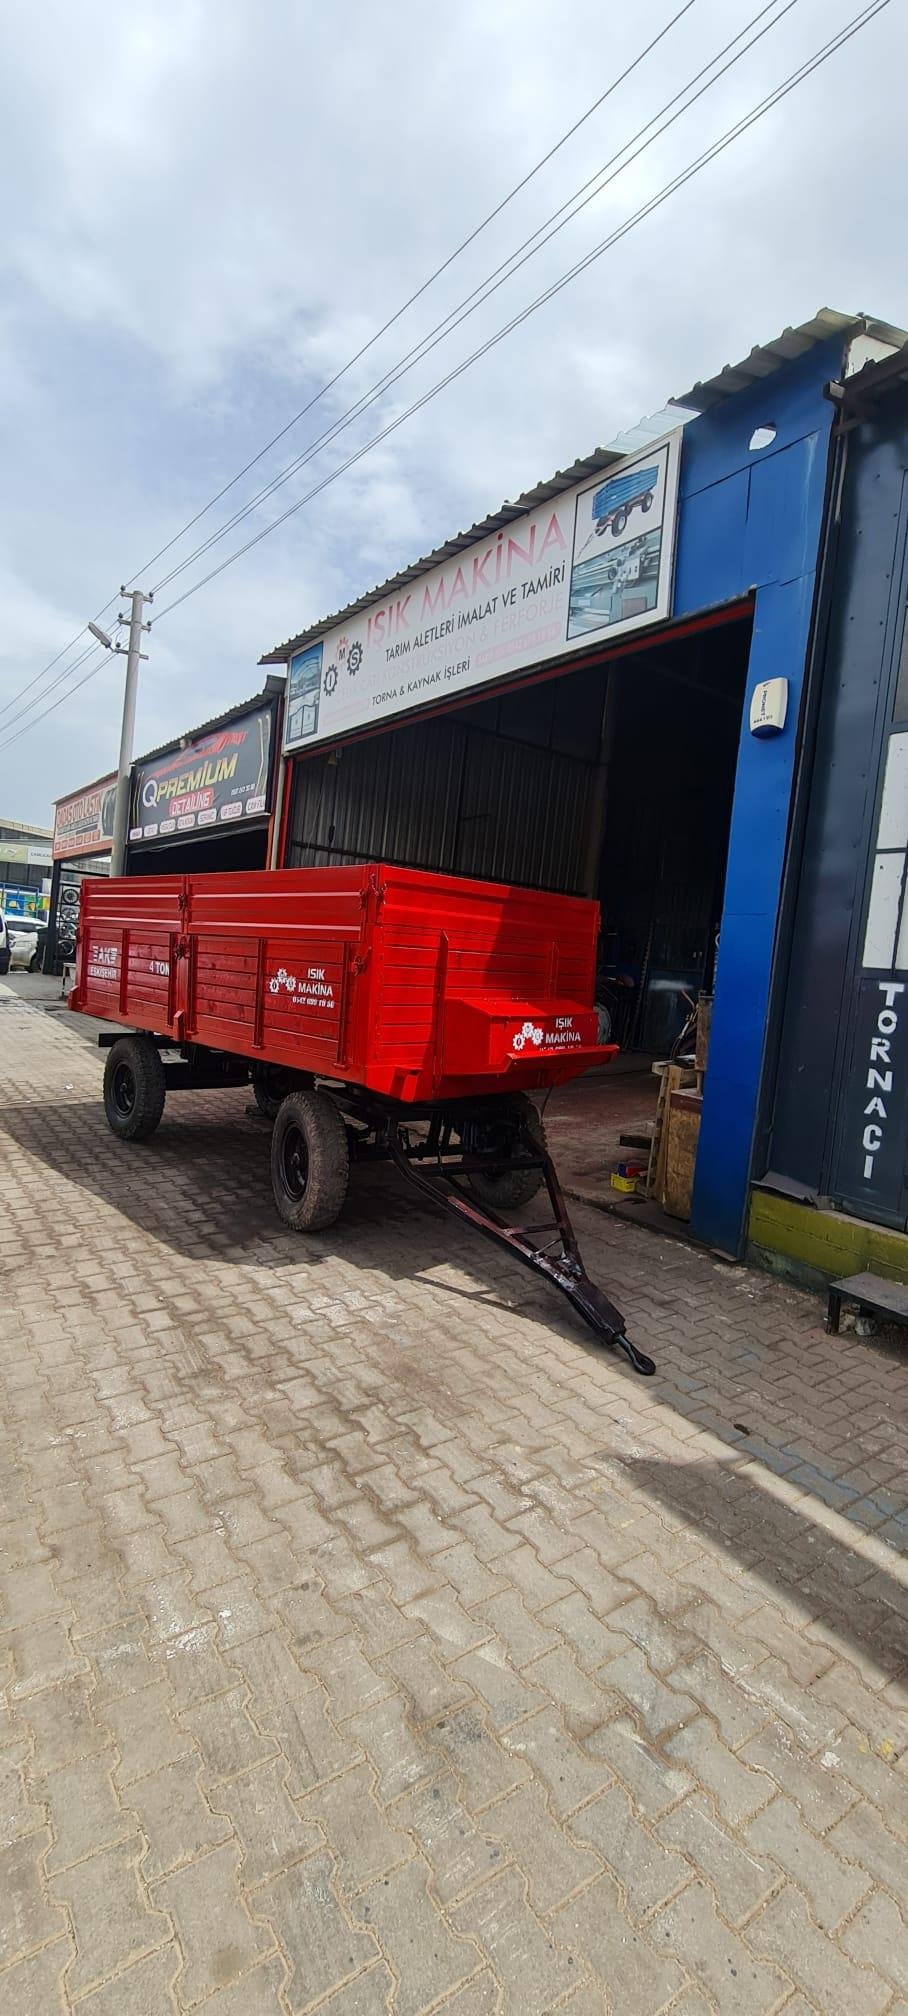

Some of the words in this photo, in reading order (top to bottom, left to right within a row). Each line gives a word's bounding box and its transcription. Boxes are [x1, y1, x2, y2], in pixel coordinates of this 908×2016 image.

[366, 594, 412, 652] IŞIK
[420, 512, 568, 622] MAKİNA
[385, 640, 411, 662] TARIM
[413, 613, 456, 650] ALETLERİ
[457, 597, 499, 630] İMALAT
[502, 587, 517, 607] VE
[520, 560, 566, 600] TAMİRİ
[372, 687, 398, 707] TORNA
[399, 685, 405, 696] &
[407, 671, 442, 693] KAYNAK
[444, 656, 471, 680] İŞLERİ
[149, 961, 154, 972] 4
[156, 961, 170, 976] TON
[298, 982, 334, 997] MAKİNA
[545, 1030, 581, 1044] MAKİNA
[555, 1017, 573, 1030] IŞIK
[862, 982, 905, 1180] TORNACI
